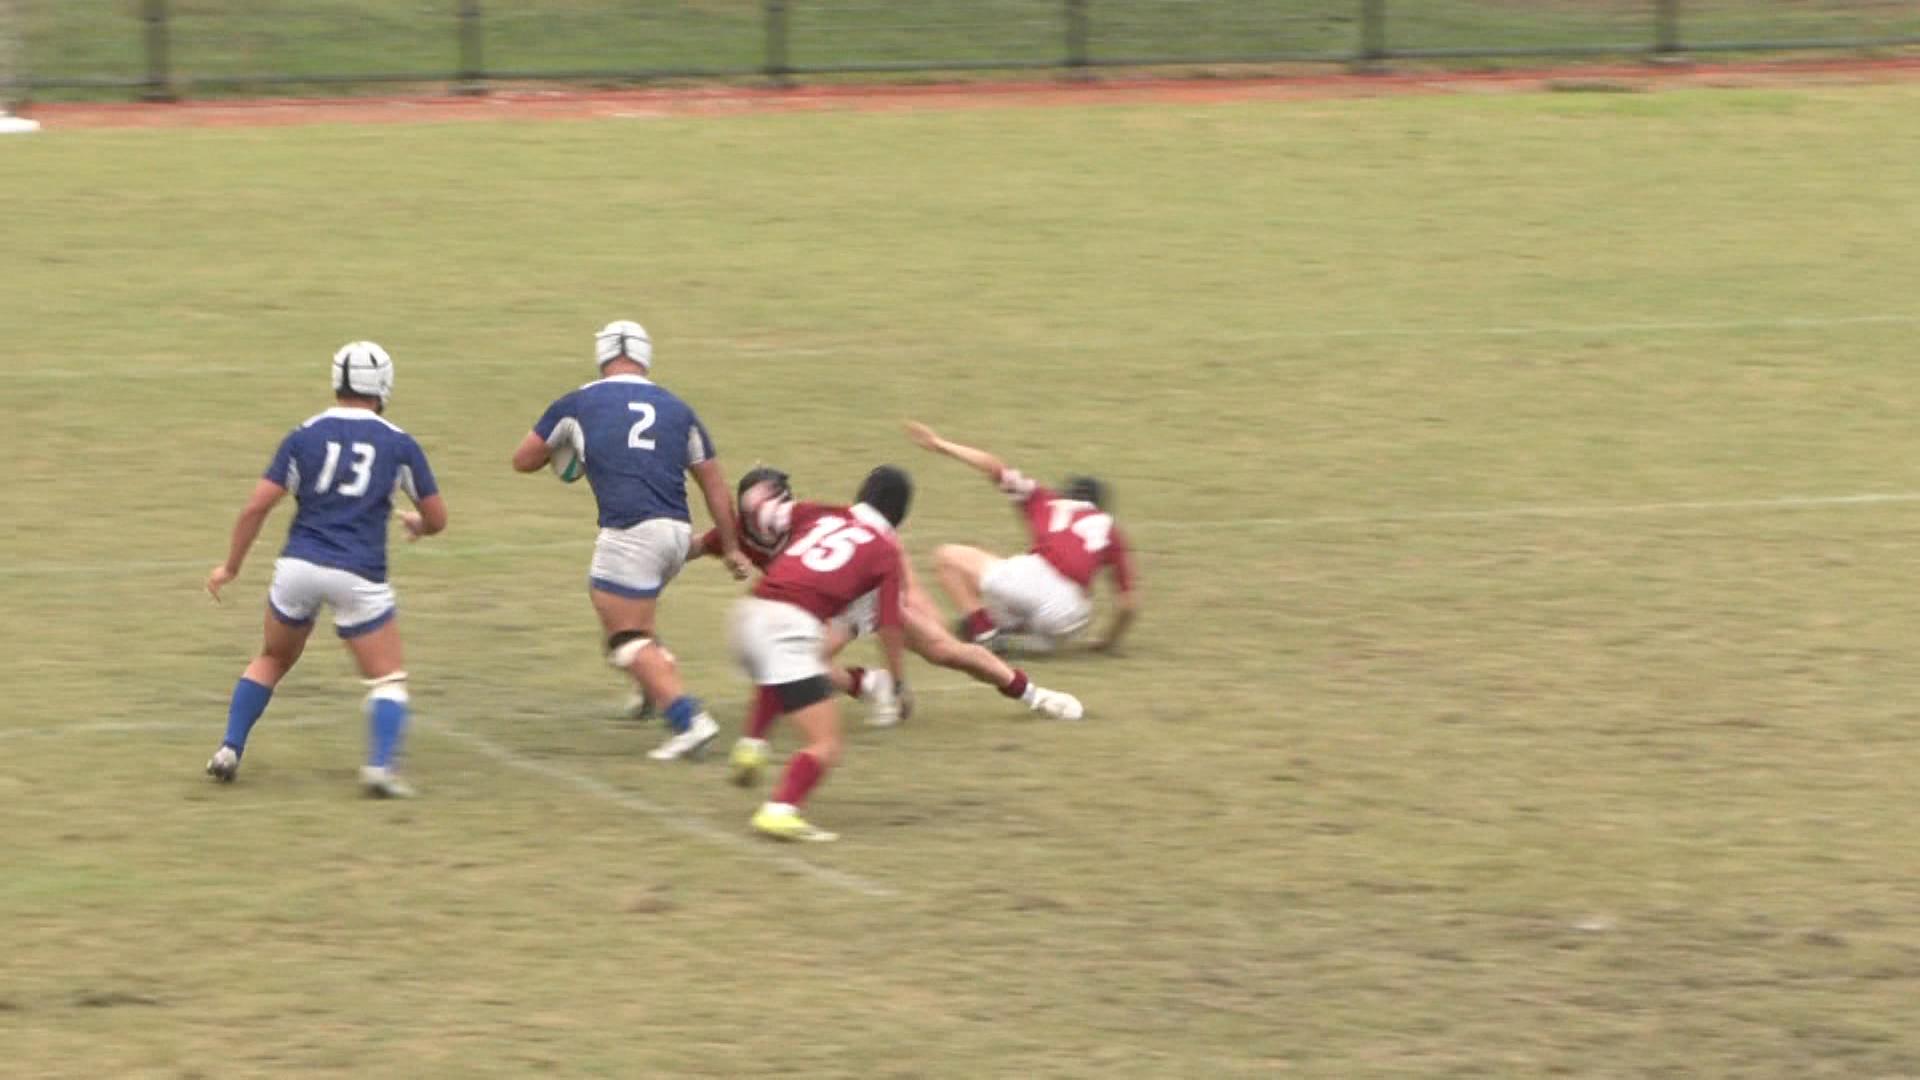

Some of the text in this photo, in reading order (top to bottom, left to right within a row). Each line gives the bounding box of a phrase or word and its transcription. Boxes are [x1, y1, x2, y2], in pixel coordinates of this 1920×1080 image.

[627, 402, 656, 450] 2
[314, 440, 377, 497] 13
[783, 515, 877, 573] 15
